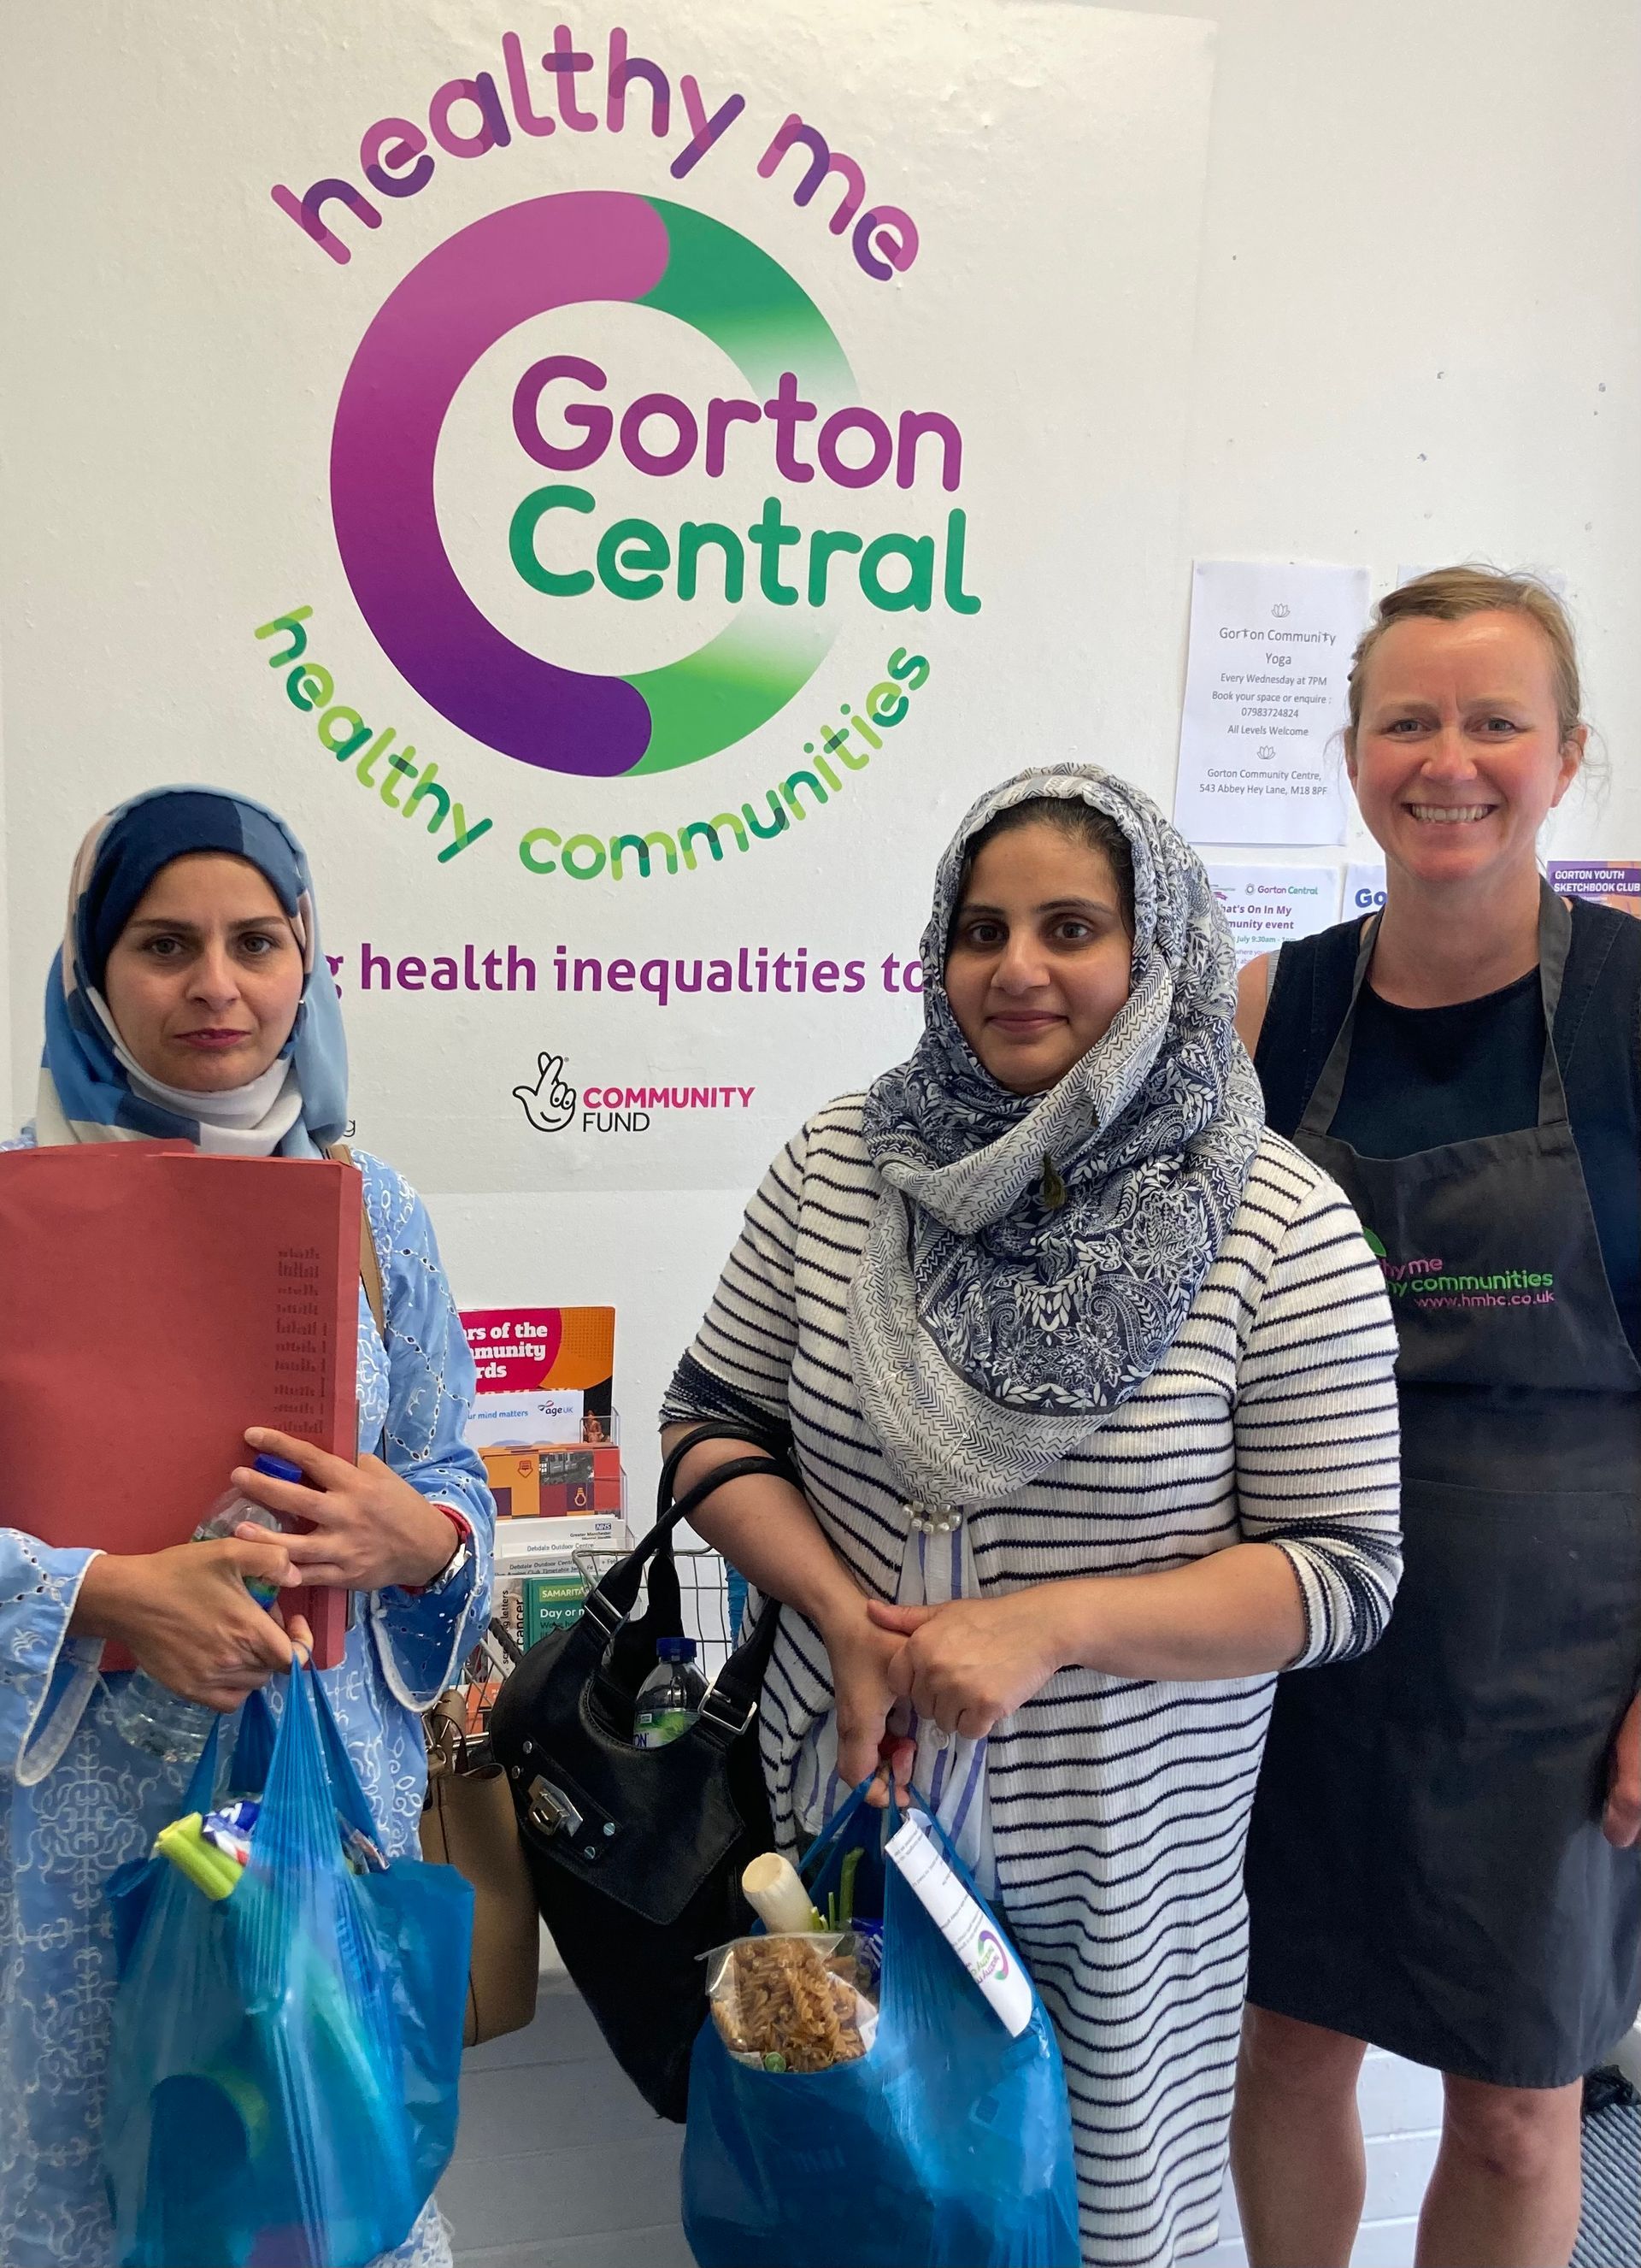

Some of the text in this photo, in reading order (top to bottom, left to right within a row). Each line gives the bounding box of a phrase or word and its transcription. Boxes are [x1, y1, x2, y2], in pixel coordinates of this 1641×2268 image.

[271, 24, 919, 281] healthy me
[513, 355, 962, 492] Gorton
[509, 485, 982, 615] Central
[1220, 627, 1337, 645] Gorton Community
[1266, 652, 1291, 667] Yoga
[1220, 673, 1327, 686] Every Wednesday at 7PM
[1212, 691, 1233, 700] Book
[1236, 692, 1254, 702] your
[1256, 693, 1280, 703] space
[1294, 694, 1326, 704] enquire
[1241, 707, 1298, 718] 07983724824
[1227, 725, 1309, 736] All Levels Welcome
[254, 604, 930, 881] healthy communities
[1207, 769, 1321, 781] Gorton Community Centre,
[1199, 784, 1327, 795] 543 Abbey Hey Lane, M18 8PF
[1555, 870, 1625, 880] GORTON YOUTH
[1257, 885, 1318, 895] Gorton Central
[1554, 882, 1641, 892] SKETCHBOOK CLUB
[1247, 905, 1261, 914] On
[1264, 905, 1273, 914] In
[1276, 906, 1291, 916] My
[1265, 921, 1294, 929] event
[1237, 935, 1250, 944] July
[361, 944, 536, 991] health
[556, 946, 866, 1006] inequalities
[583, 1086, 756, 1109] COMMUNITY
[583, 1112, 650, 1132] FUND
[1409, 1258, 1443, 1275] me
[1411, 1269, 1553, 1293] communities
[1414, 1290, 1555, 1308] www.hmhc.co.uk
[490, 1322, 511, 1340] of
[515, 1322, 548, 1339] the
[478, 1411, 497, 1420] mind
[499, 1410, 528, 1419] matters
[500, 1590, 509, 1618] letters
[540, 1608, 562, 1619] Day
[515, 1599, 524, 1646] cancer
